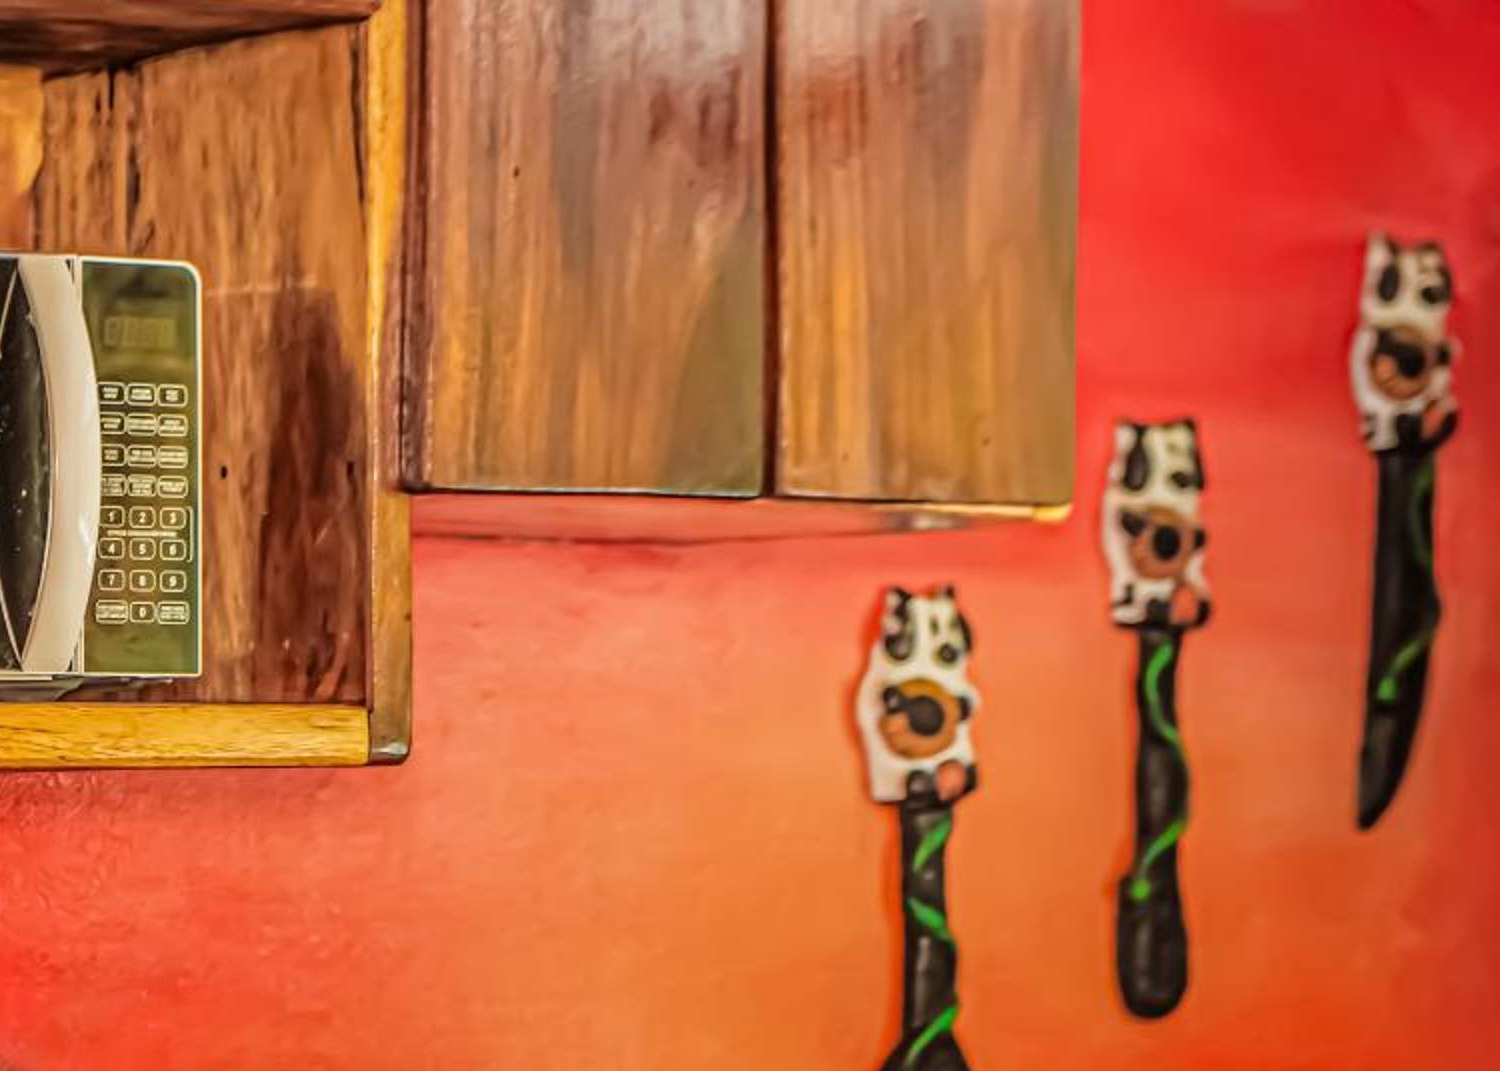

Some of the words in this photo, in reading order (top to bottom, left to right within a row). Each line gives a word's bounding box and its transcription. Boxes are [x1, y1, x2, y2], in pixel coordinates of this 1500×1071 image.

[108, 510, 116, 523] 1
[138, 511, 147, 524] 2
[108, 543, 116, 555] 4
[139, 543, 147, 555] 5
[108, 573, 116, 586] 7
[169, 575, 177, 587] 9
[139, 607, 147, 619] 0
